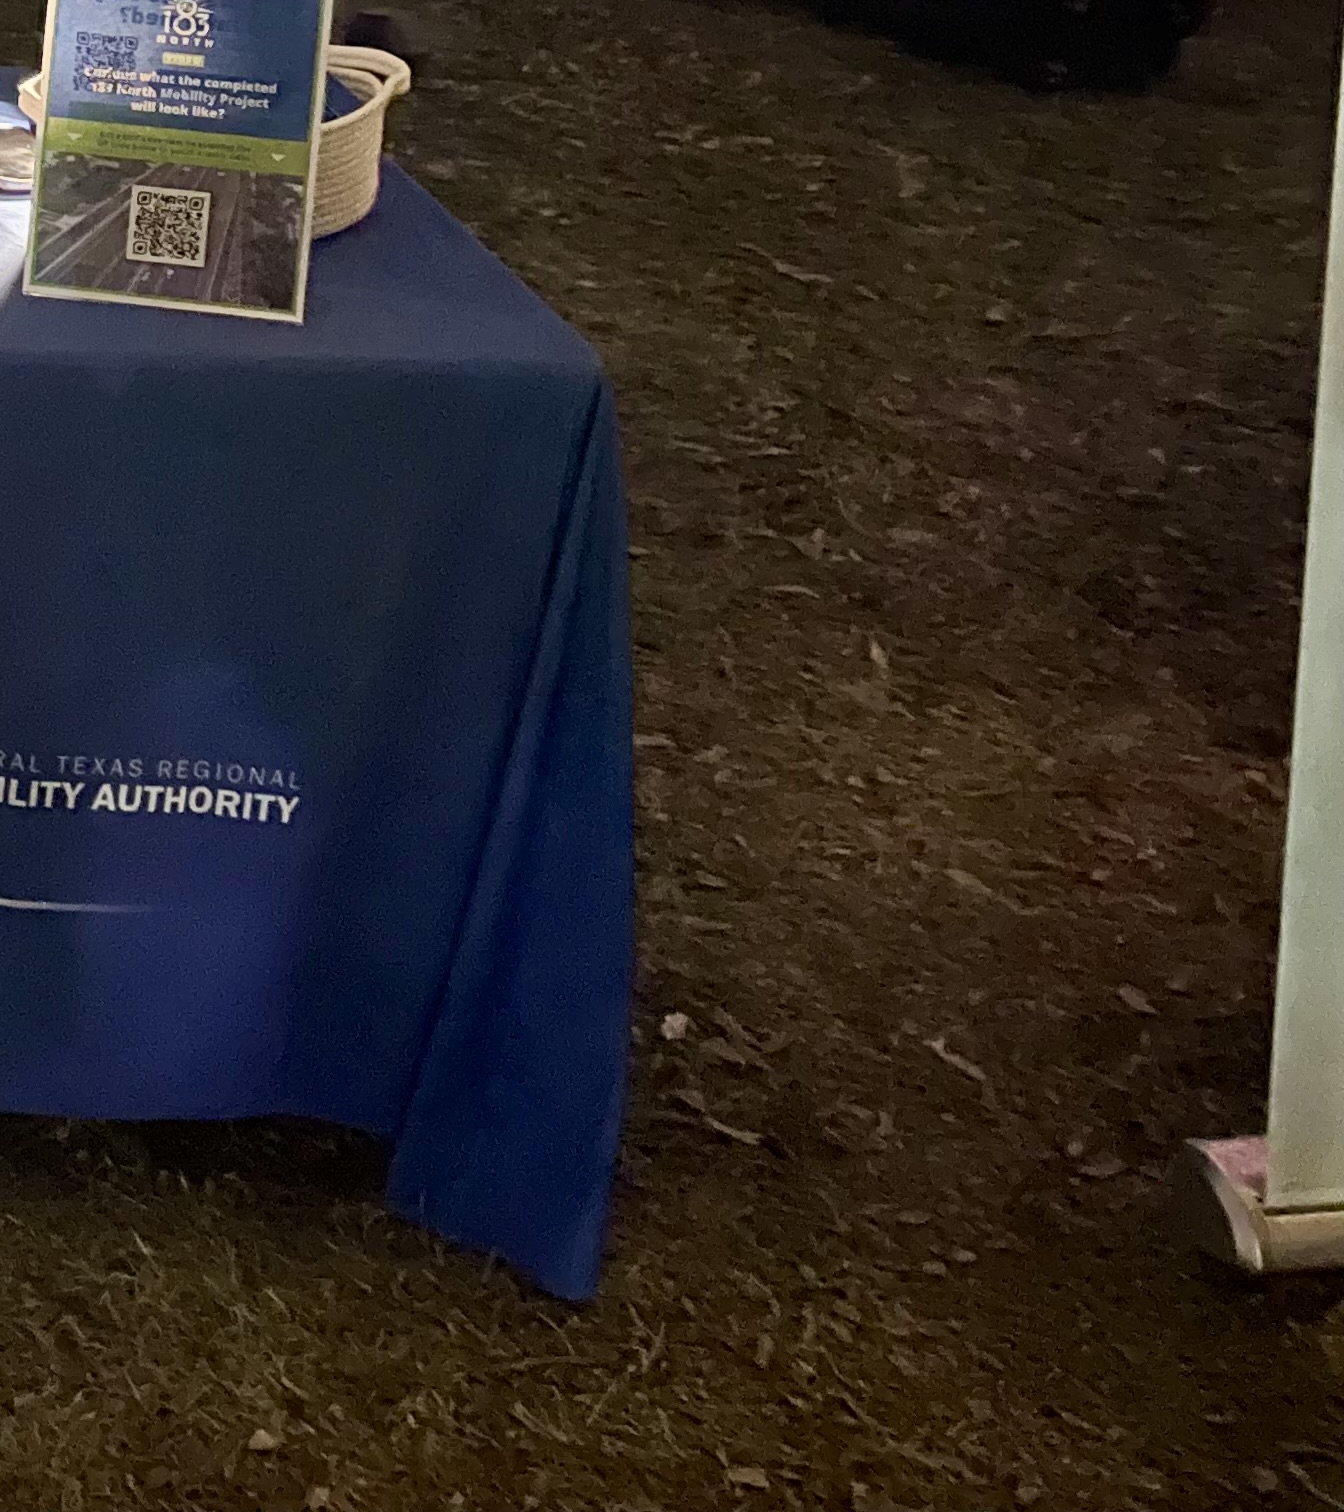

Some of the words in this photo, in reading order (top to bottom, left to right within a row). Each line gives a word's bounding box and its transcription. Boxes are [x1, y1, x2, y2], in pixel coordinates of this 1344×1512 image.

[156, 35, 215, 48] NORTH
[90, 81, 114, 93] 183
[116, 83, 157, 98] North
[160, 89, 216, 106] Mobility
[220, 93, 270, 110] Project
[139, 71, 176, 85] what
[178, 74, 201, 87] the
[204, 77, 278, 94] completed
[131, 101, 156, 113] will
[159, 104, 189, 116] look
[192, 106, 225, 120] like?
[56, 755, 144, 779] TEXAS
[158, 759, 300, 790] REGIONAL
[91, 783, 300, 825] AUTHORITY
